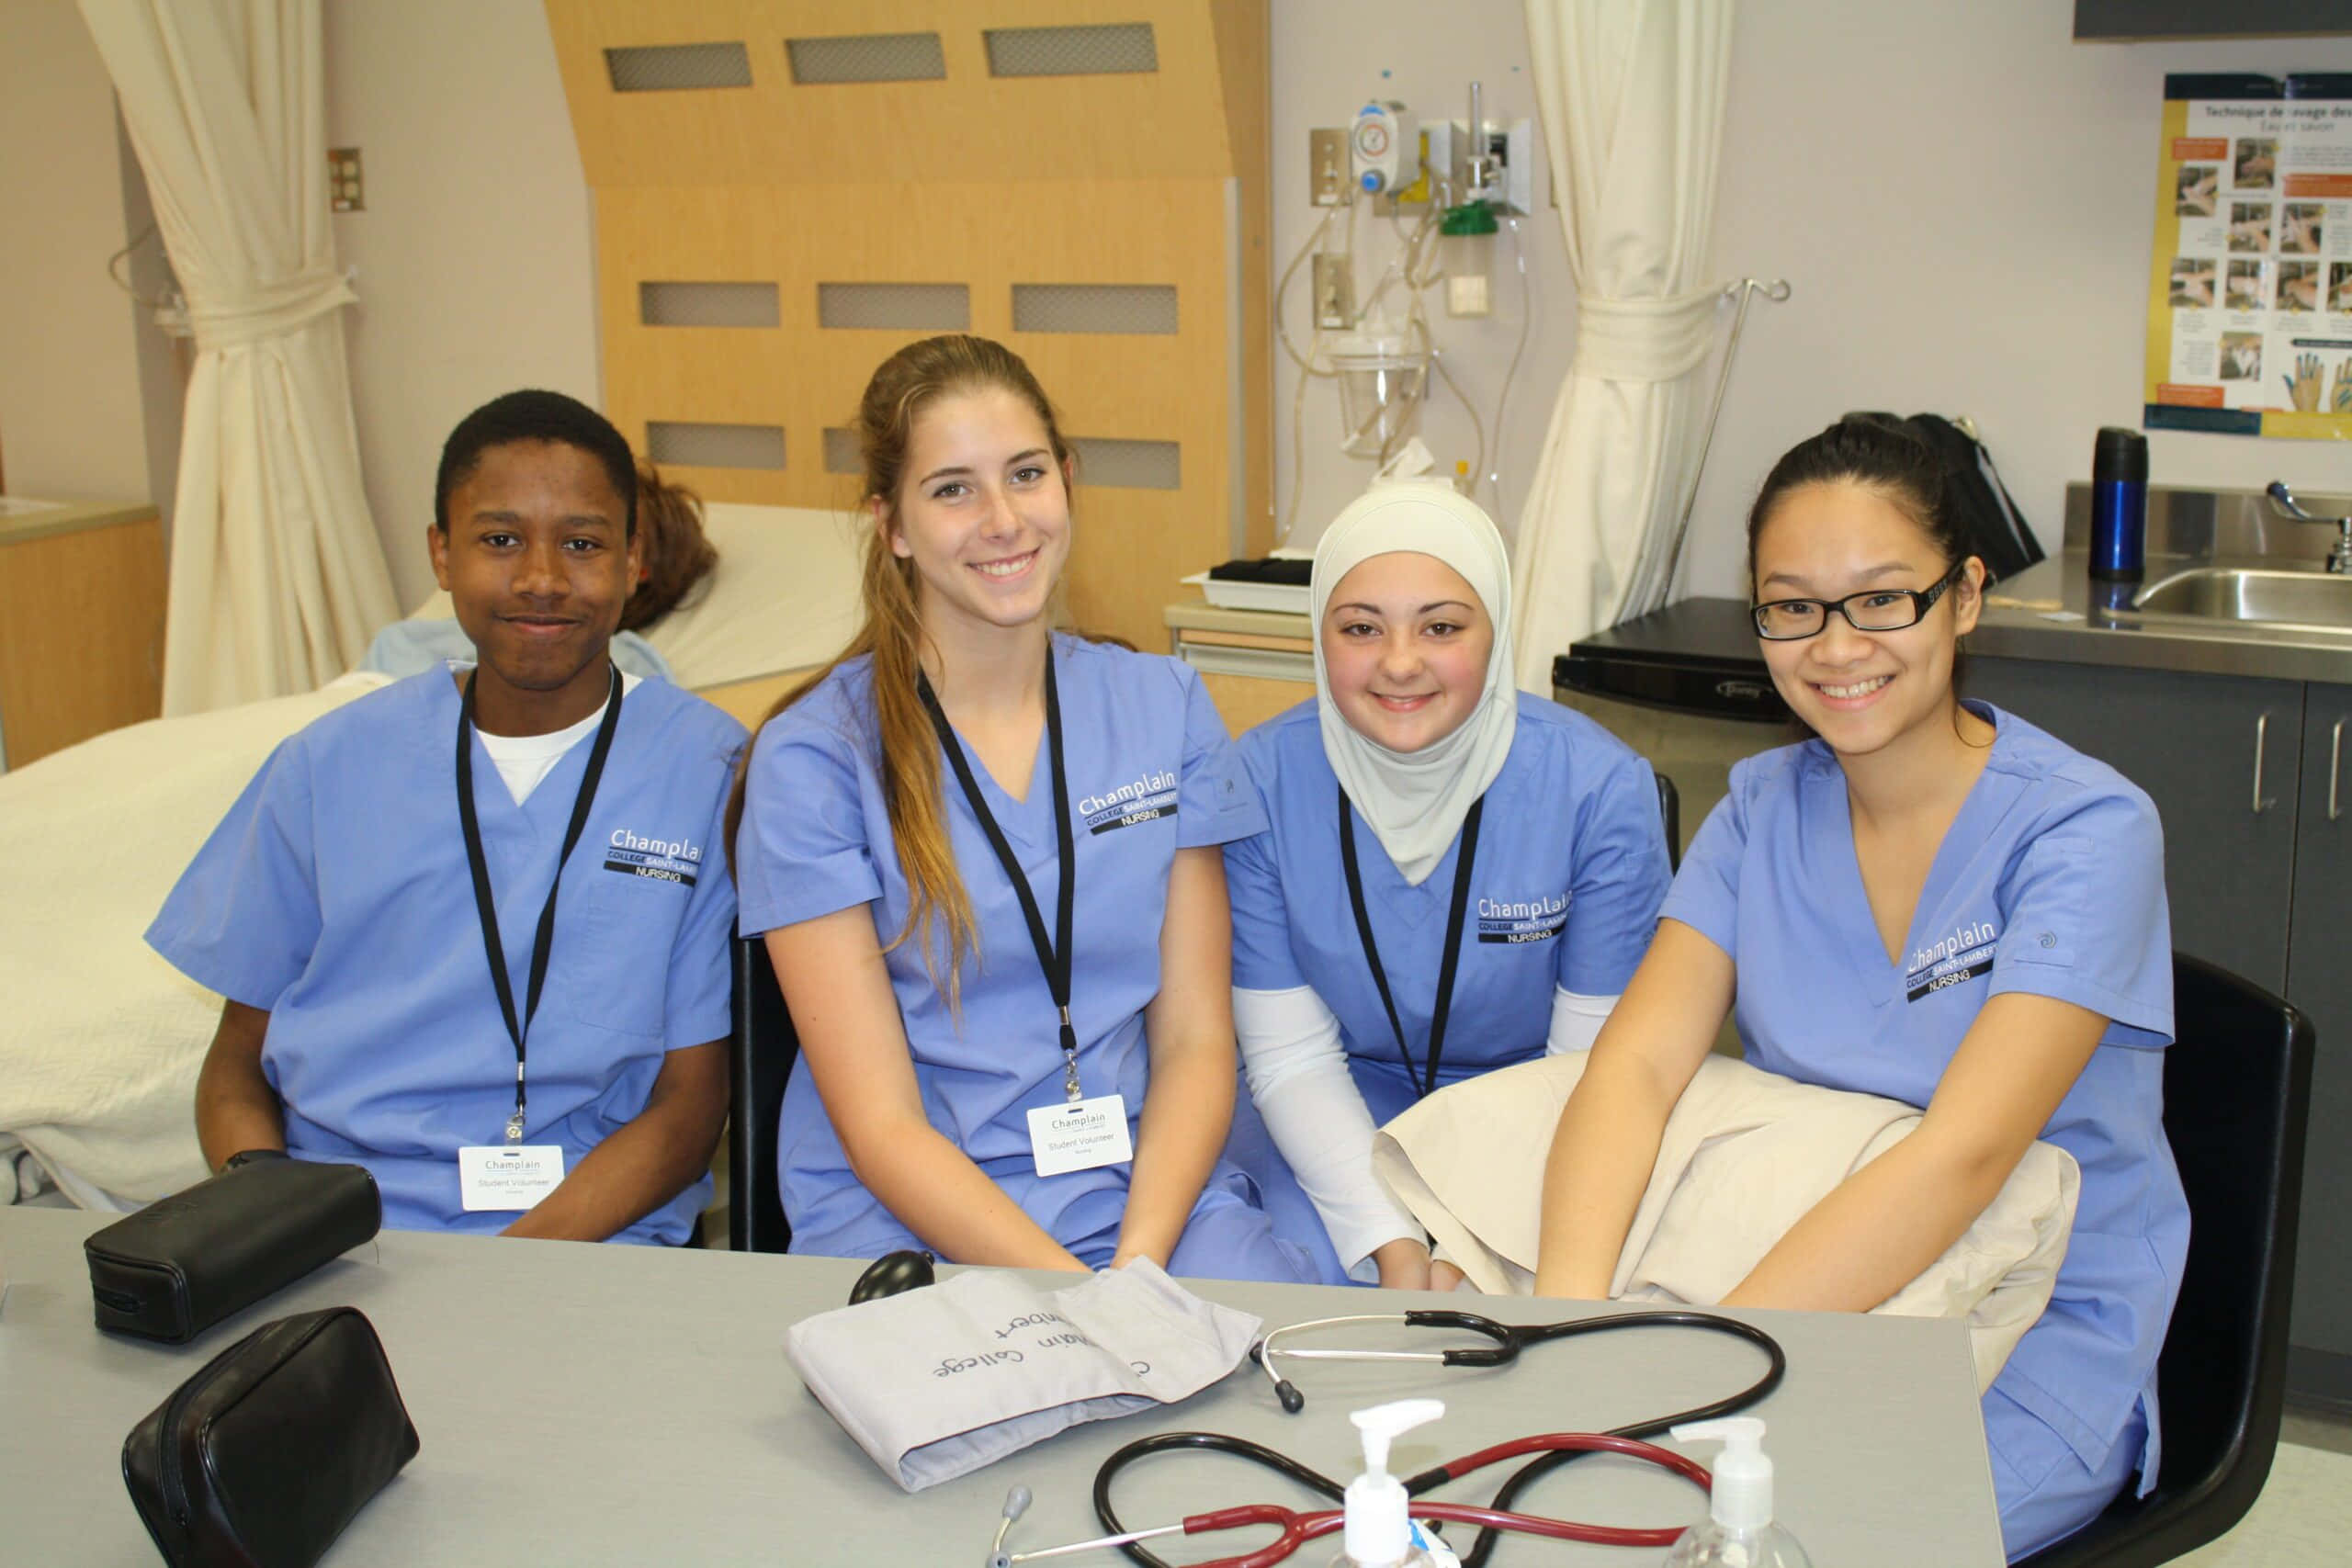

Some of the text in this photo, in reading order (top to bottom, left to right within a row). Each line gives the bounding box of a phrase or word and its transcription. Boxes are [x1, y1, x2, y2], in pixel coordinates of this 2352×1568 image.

[2206, 106, 2266, 120] Technique
[2269, 106, 2284, 118] de
[1079, 770, 1176, 816] Champlain
[1087, 807, 1125, 827] COLLEGE
[1121, 808, 1160, 827] NURSING
[610, 829, 699, 861] Champla
[607, 851, 646, 863] COLLEGE
[635, 866, 682, 883] NURSING
[1508, 929, 1553, 943] NURSING
[1908, 920, 1996, 973] Champlain
[1906, 944, 1997, 989] COLLEGE SAINT-LAMBERT
[1928, 969, 1972, 993] NURSING
[1051, 1113, 1106, 1130] Champlain
[1048, 1138, 1078, 1152] Student
[1079, 1134, 1114, 1145] Volunteer
[484, 1160, 541, 1171] Champlain
[933, 1349, 1025, 1379] College
